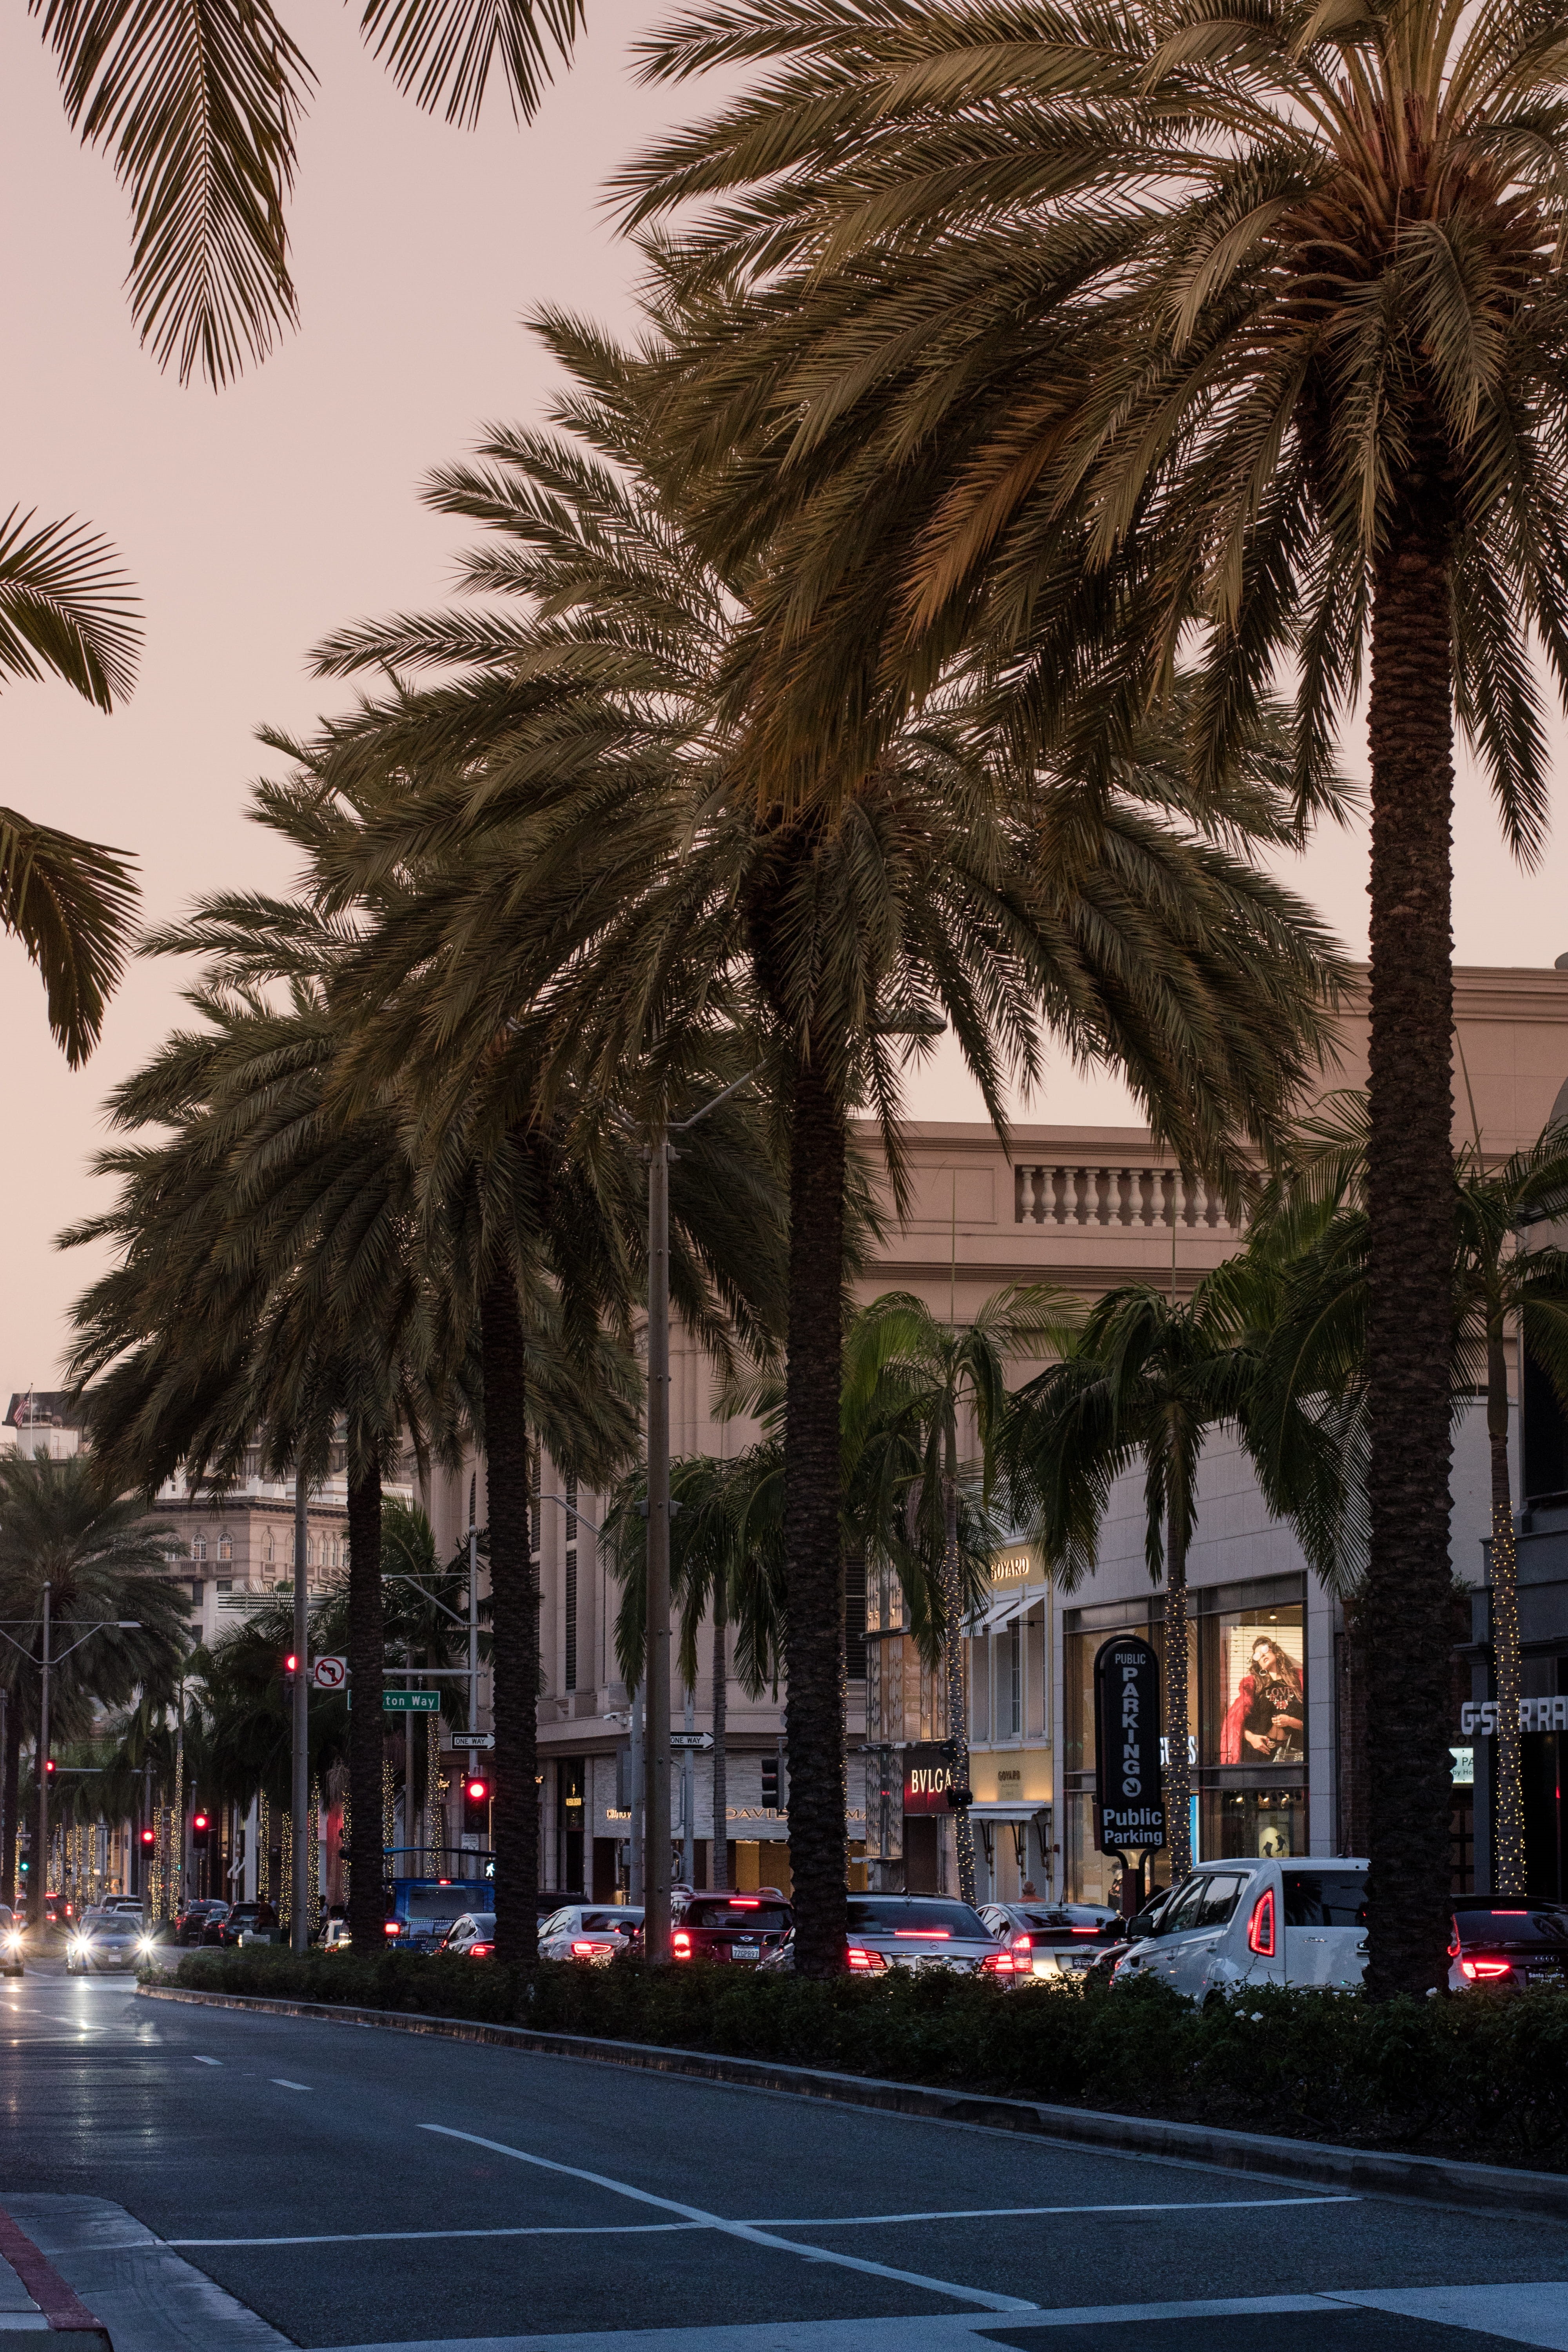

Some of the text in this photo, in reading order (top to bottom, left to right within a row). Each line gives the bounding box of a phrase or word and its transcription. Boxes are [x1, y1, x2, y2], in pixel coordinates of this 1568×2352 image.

[990, 1557, 1028, 1580] GOYARD
[1115, 1653, 1146, 1664] PUBLIC
[1265, 1687, 1294, 1697] LOVE
[383, 1695, 435, 1708] ton Way
[1122, 1667, 1140, 1775] PARKING
[1461, 1698, 1532, 1735] G-SR
[911, 1768, 951, 1793] BVLGA
[726, 1808, 789, 1818] DAVID
[1103, 1808, 1162, 1826] Public
[1104, 1829, 1163, 1846] Parking
